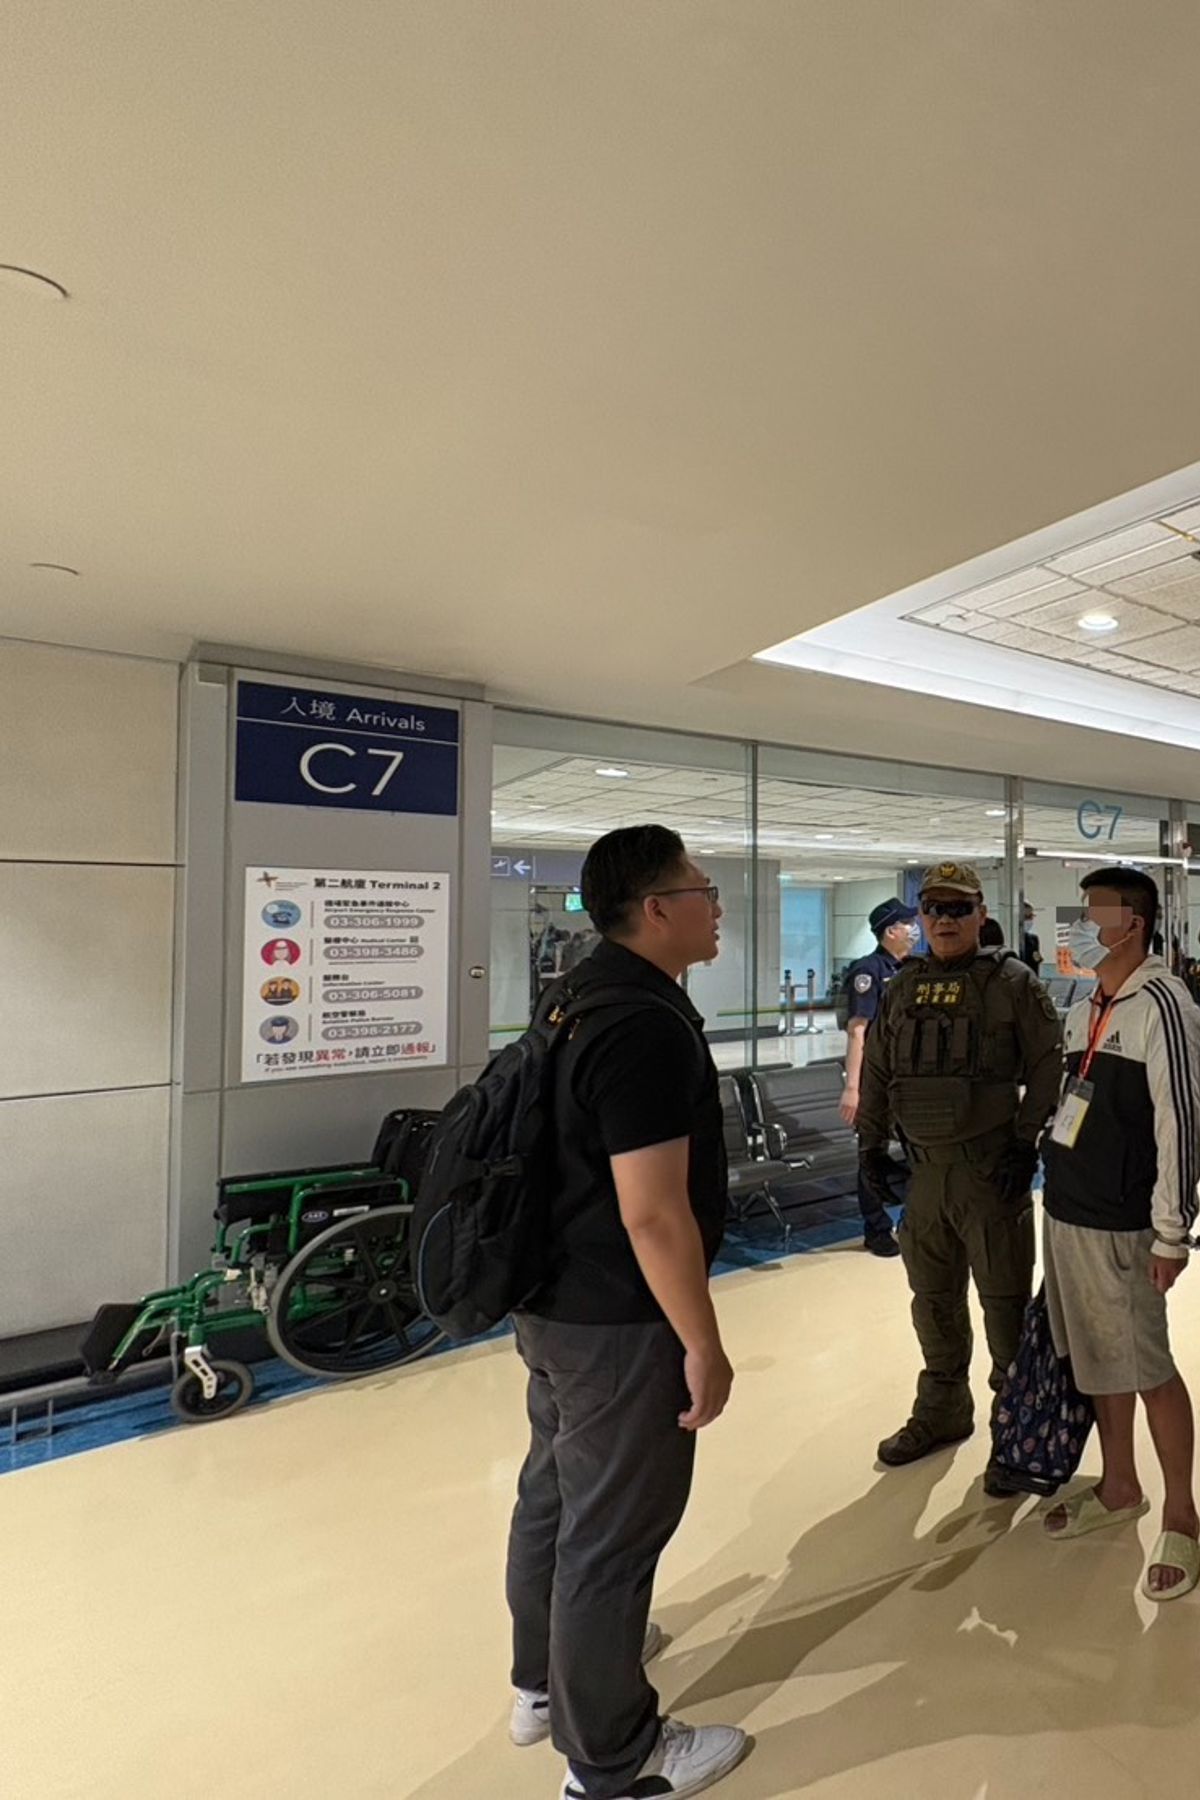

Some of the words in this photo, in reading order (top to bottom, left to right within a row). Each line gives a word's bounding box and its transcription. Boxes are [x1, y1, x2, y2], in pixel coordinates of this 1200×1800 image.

[280, 696, 337, 720] 入境
[345, 708, 426, 731] Arrivals
[299, 743, 404, 796] C7
[1077, 800, 1122, 840] C7
[369, 880, 429, 890] Terminal
[432, 882, 441, 891] 2
[916, 994, 958, 1004] CIB
[917, 981, 960, 995] 刑事局
